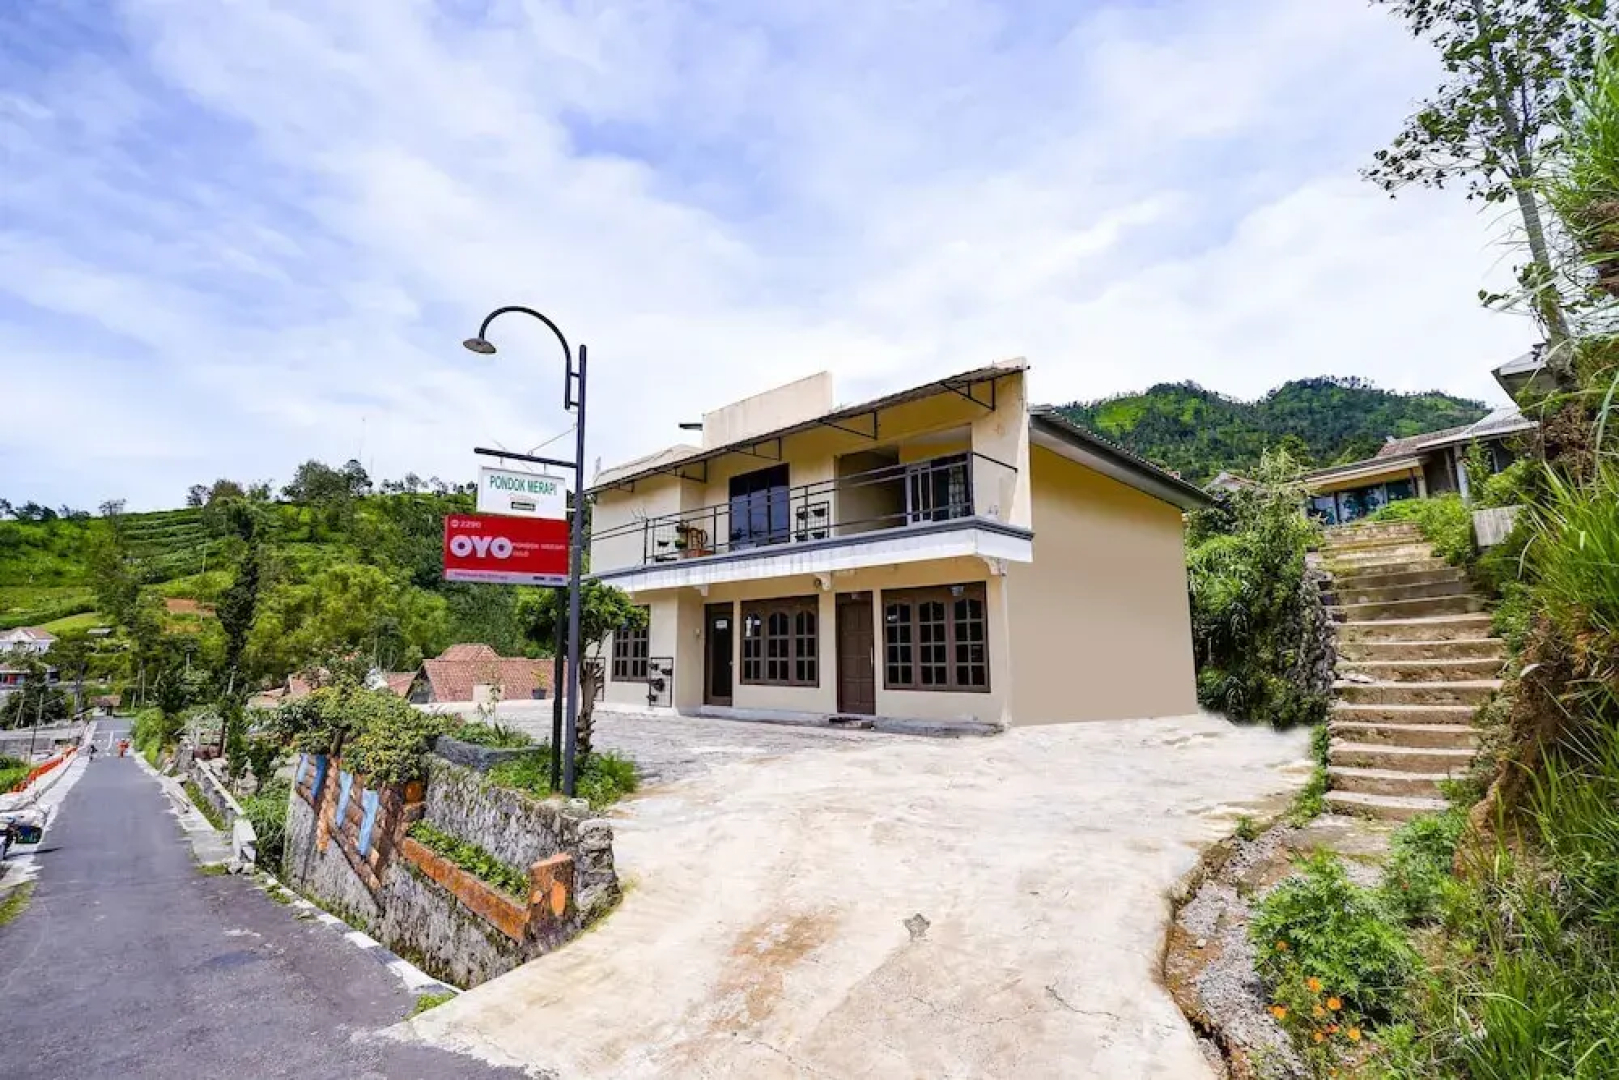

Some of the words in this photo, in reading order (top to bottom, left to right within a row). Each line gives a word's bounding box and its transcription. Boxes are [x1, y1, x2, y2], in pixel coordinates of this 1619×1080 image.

[490, 475, 526, 492] PONDOK
[527, 480, 558, 496] MERAPI
[450, 535, 512, 559] OYO
